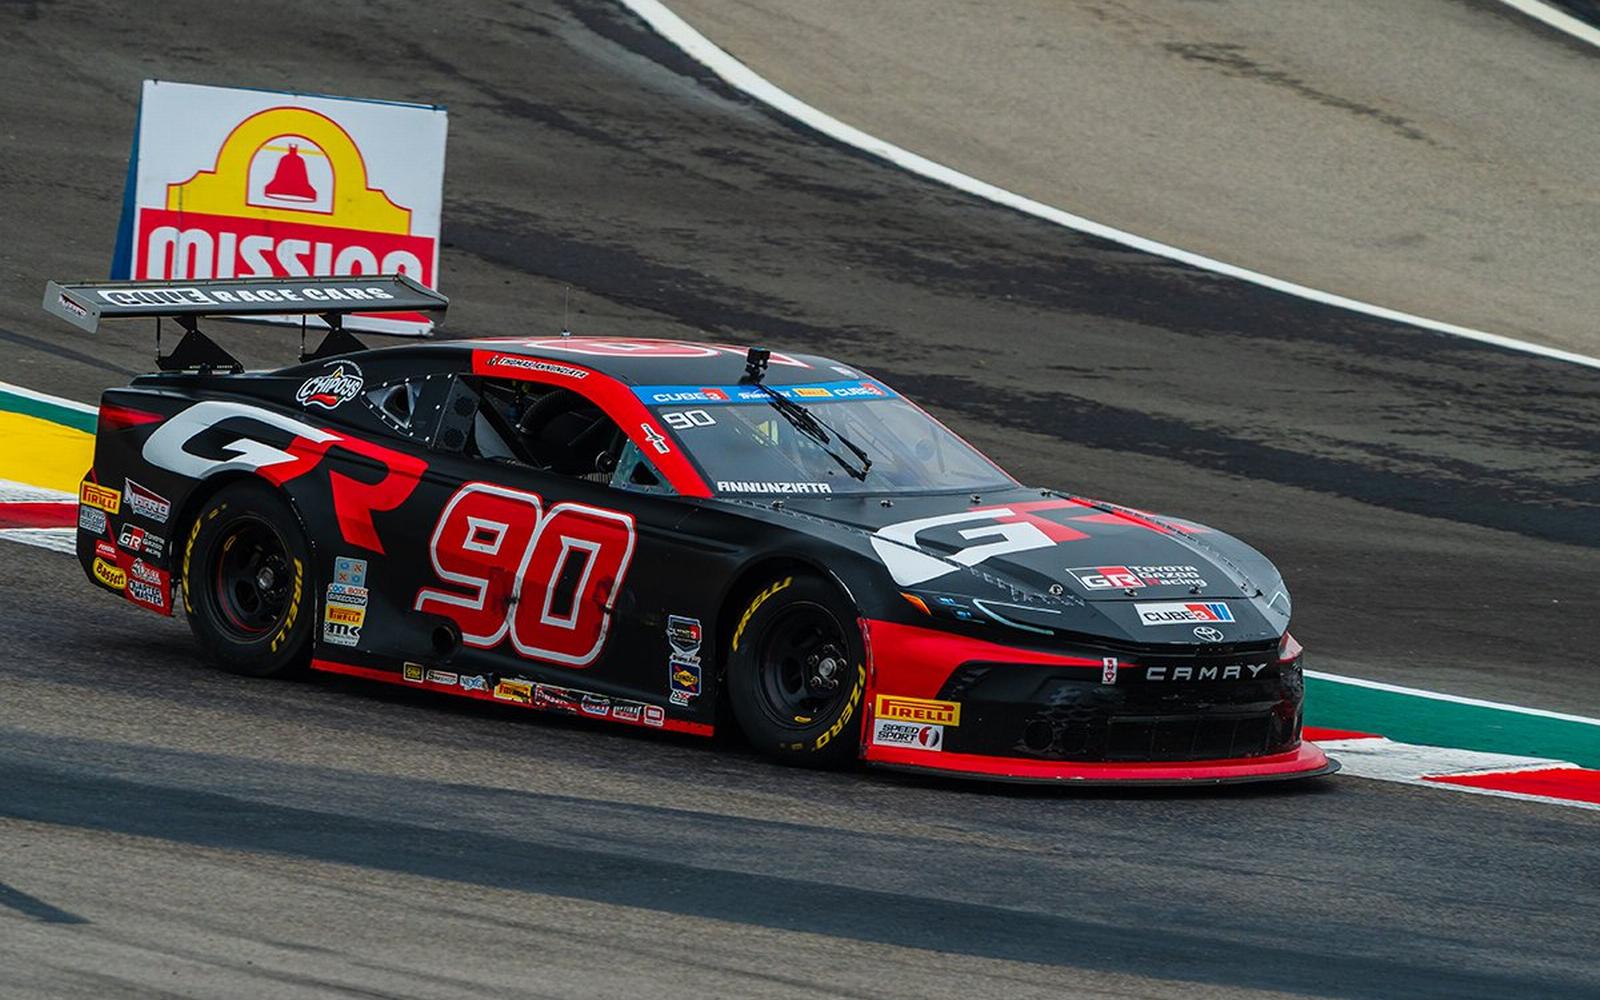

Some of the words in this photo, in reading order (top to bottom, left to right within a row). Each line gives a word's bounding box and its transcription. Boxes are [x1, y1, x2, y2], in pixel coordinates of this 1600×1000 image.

[210, 288, 302, 302] RACE
[302, 286, 394, 300] CARS
[300, 376, 361, 398] CHIPOYS
[662, 409, 717, 430] 90
[142, 401, 428, 555] GR
[717, 480, 833, 494] ANNUNZIATA
[83, 484, 118, 510] PIRELLI
[120, 532, 142, 548] GR
[413, 480, 636, 668] 90
[1128, 565, 1198, 573] TOYOTA
[1136, 571, 1201, 579] GAZOO
[1080, 574, 1144, 588] GR
[1145, 578, 1208, 588] Racing
[1143, 609, 1210, 622] CUBE3
[1146, 663, 1268, 681] CAMRY
[816, 683, 863, 750] ZERO
[880, 698, 955, 722] PIRELLI
[878, 731, 918, 742] SPORT
[882, 723, 919, 735] SPEED
